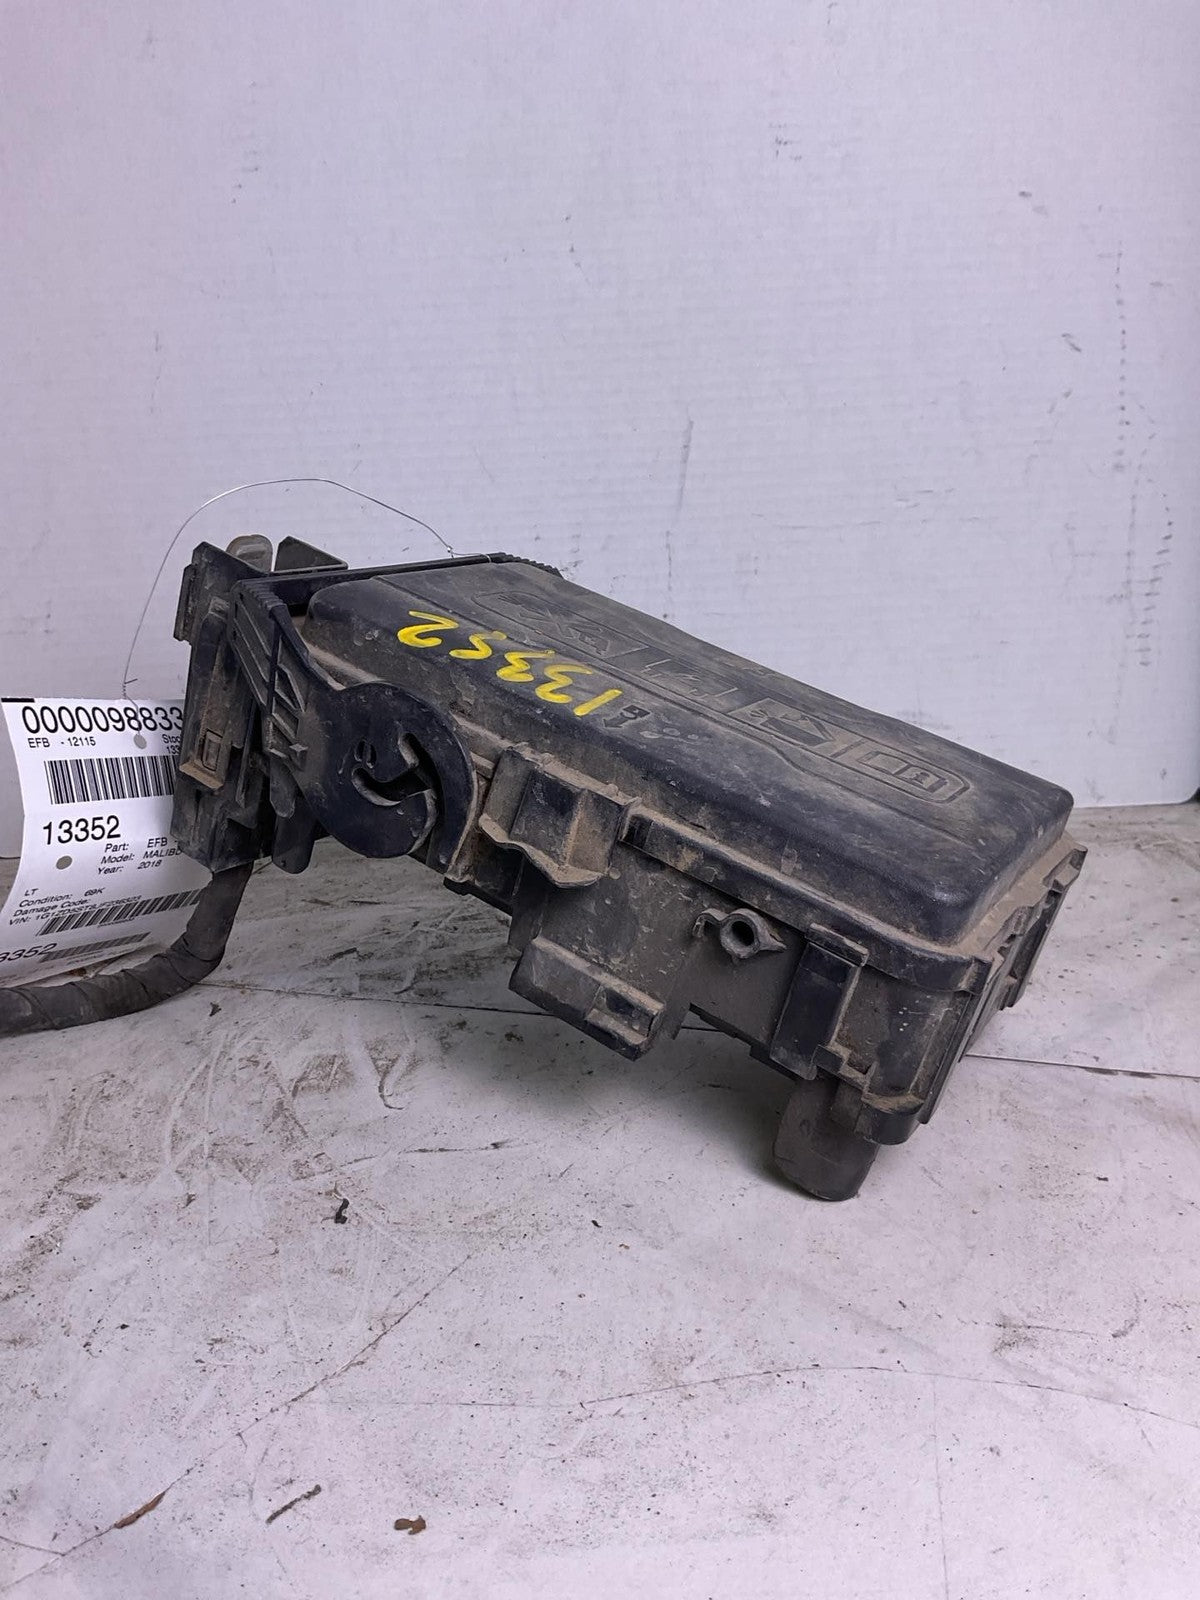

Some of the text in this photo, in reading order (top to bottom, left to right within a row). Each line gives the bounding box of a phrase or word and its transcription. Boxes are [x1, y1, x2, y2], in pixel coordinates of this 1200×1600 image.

[397, 610, 623, 717] 13352
[27, 737, 51, 748] EFB
[43, 815, 121, 845] 13352
[104, 842, 130, 853] Part:
[146, 837, 169, 849] EFB
[100, 852, 136, 864] Model:
[97, 866, 124, 875] Year:
[24, 887, 39, 897] LT
[19, 893, 73, 908] Condition:
[13, 904, 58, 917] Damage
